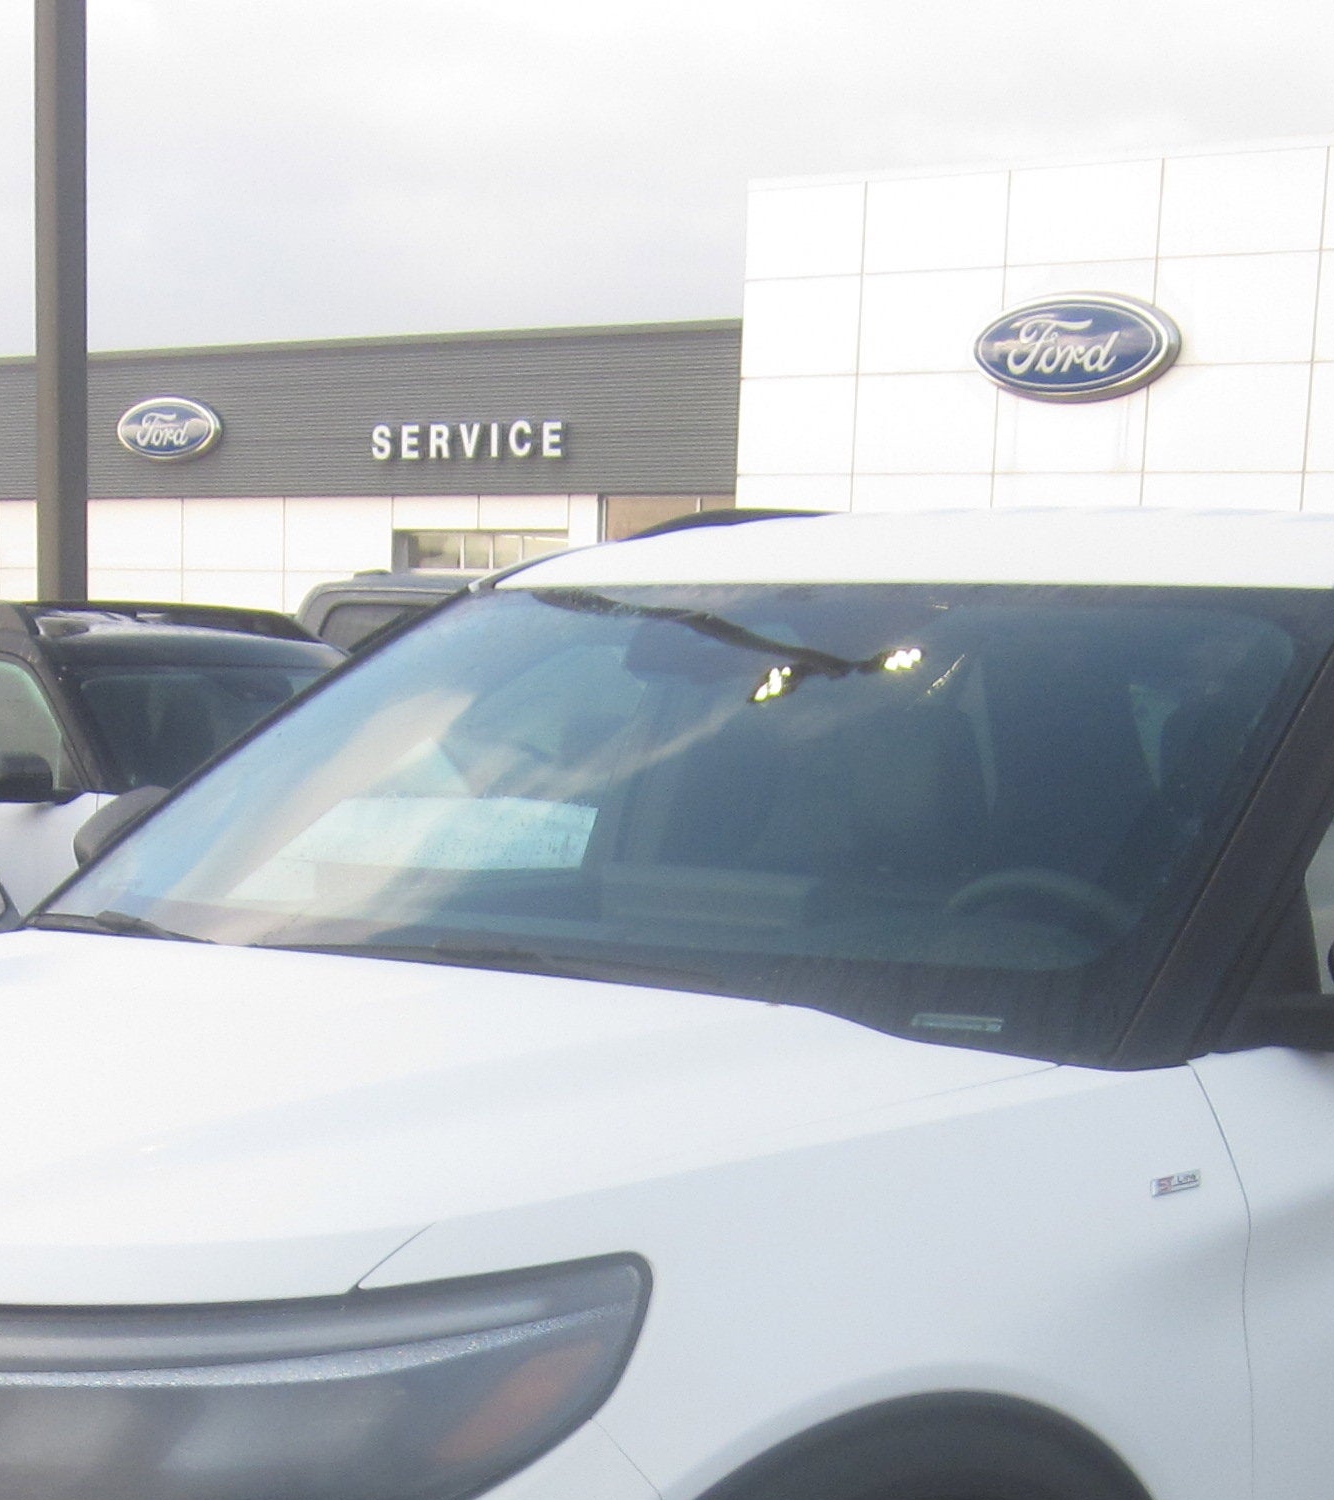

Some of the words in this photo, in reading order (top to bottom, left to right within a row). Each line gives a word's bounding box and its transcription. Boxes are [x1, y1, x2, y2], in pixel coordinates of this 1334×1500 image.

[1007, 318, 1120, 374] Ford
[137, 414, 189, 447] Ford
[371, 420, 563, 460] SERVICE
